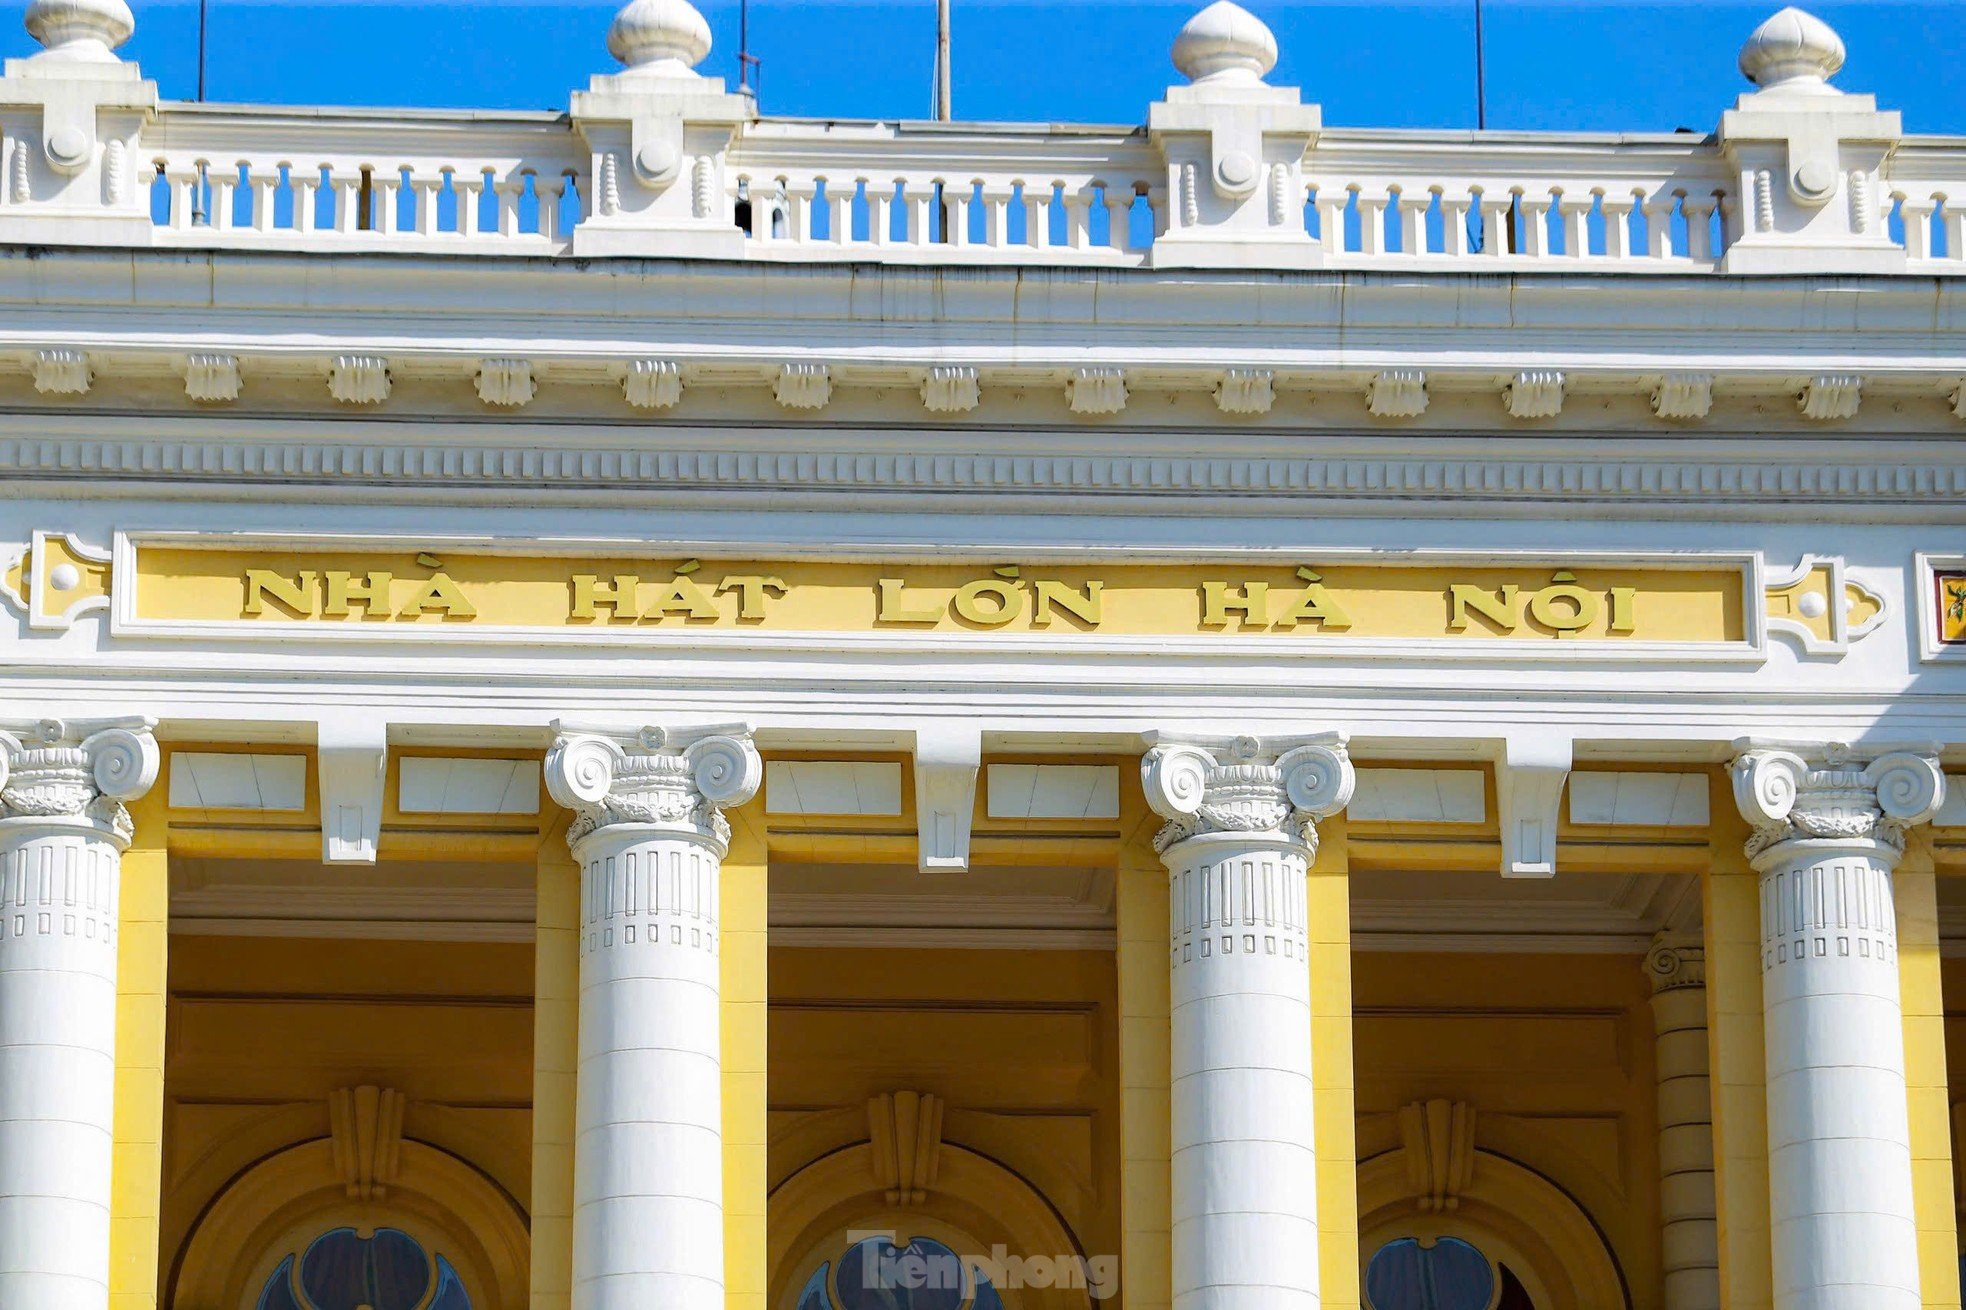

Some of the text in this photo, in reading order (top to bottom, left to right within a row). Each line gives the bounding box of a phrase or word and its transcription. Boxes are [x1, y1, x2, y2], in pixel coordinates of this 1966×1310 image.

[243, 552, 1636, 639] NHÀ HÁT LỚN HÀ NỘI
